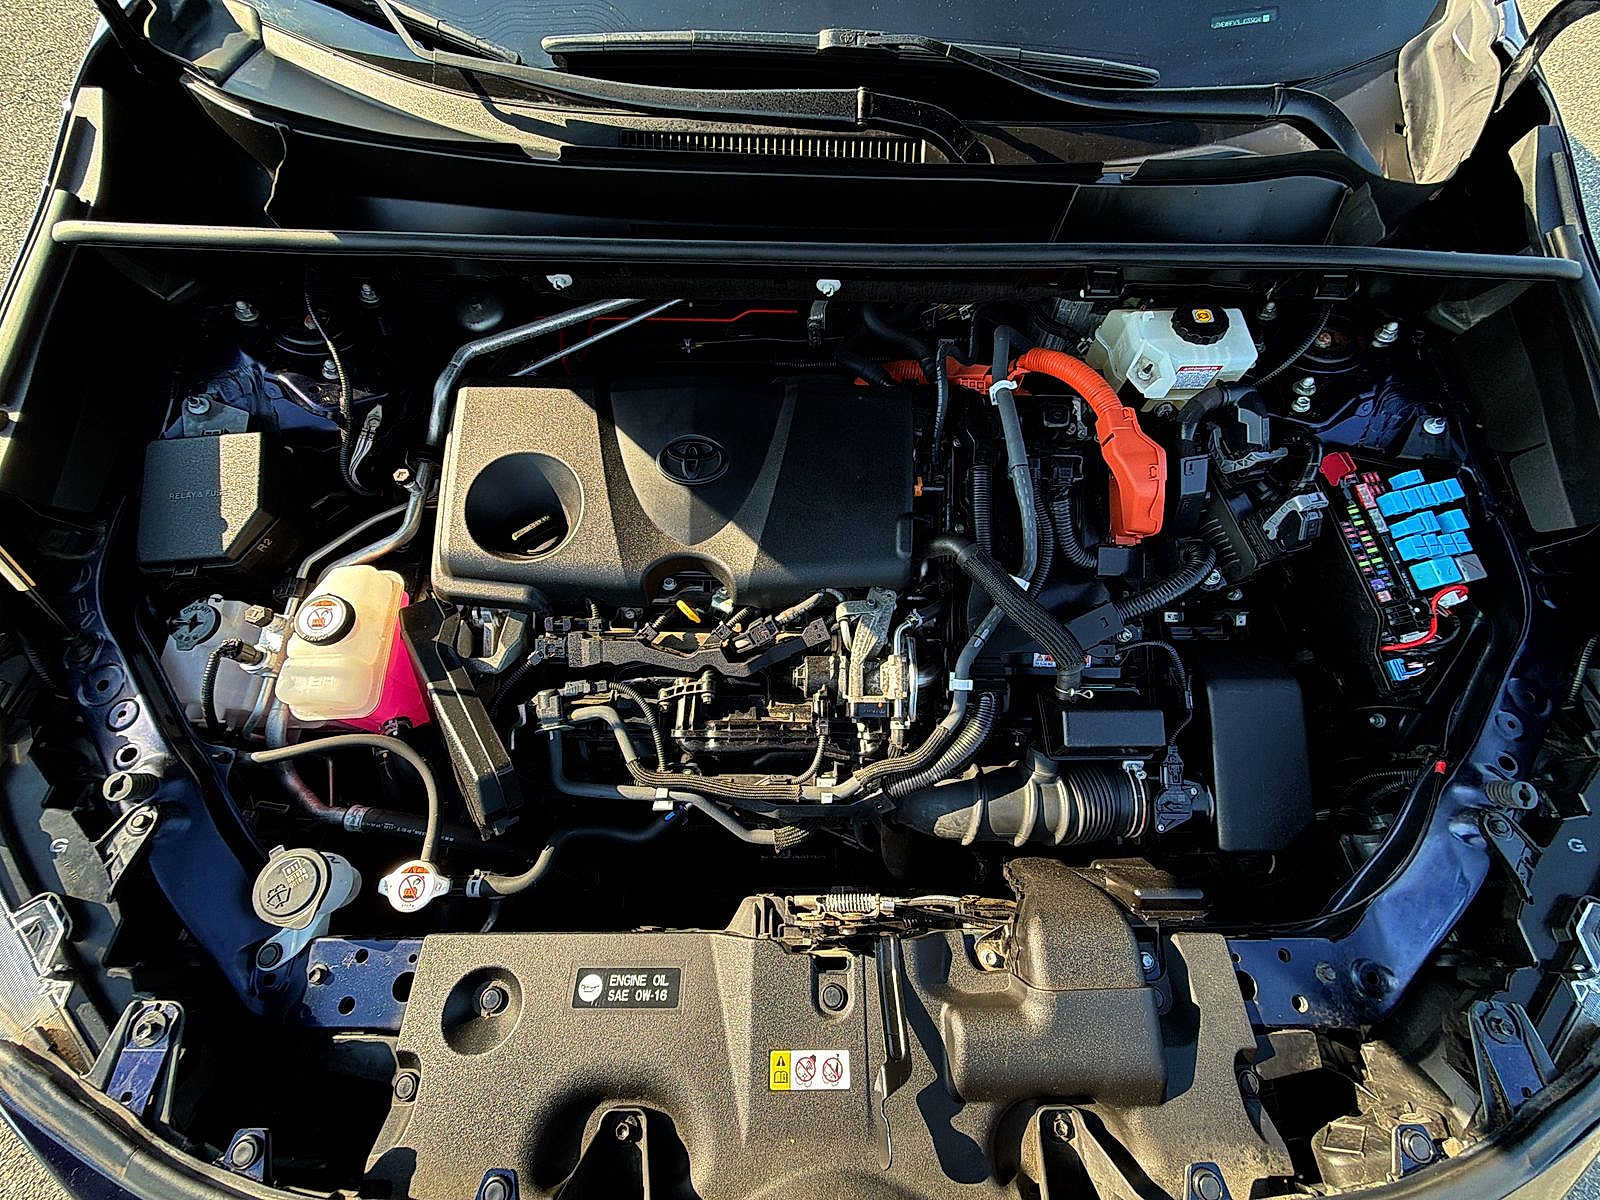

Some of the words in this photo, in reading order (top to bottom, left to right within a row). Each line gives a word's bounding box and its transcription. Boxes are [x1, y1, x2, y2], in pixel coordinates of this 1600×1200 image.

[168, 490, 197, 500] RELAY
[257, 538, 273, 552] R2
[609, 974, 647, 987] ENGINE
[652, 974, 669, 987] OIL
[607, 989, 630, 1002] SAE
[635, 989, 668, 1002] 0W-16
